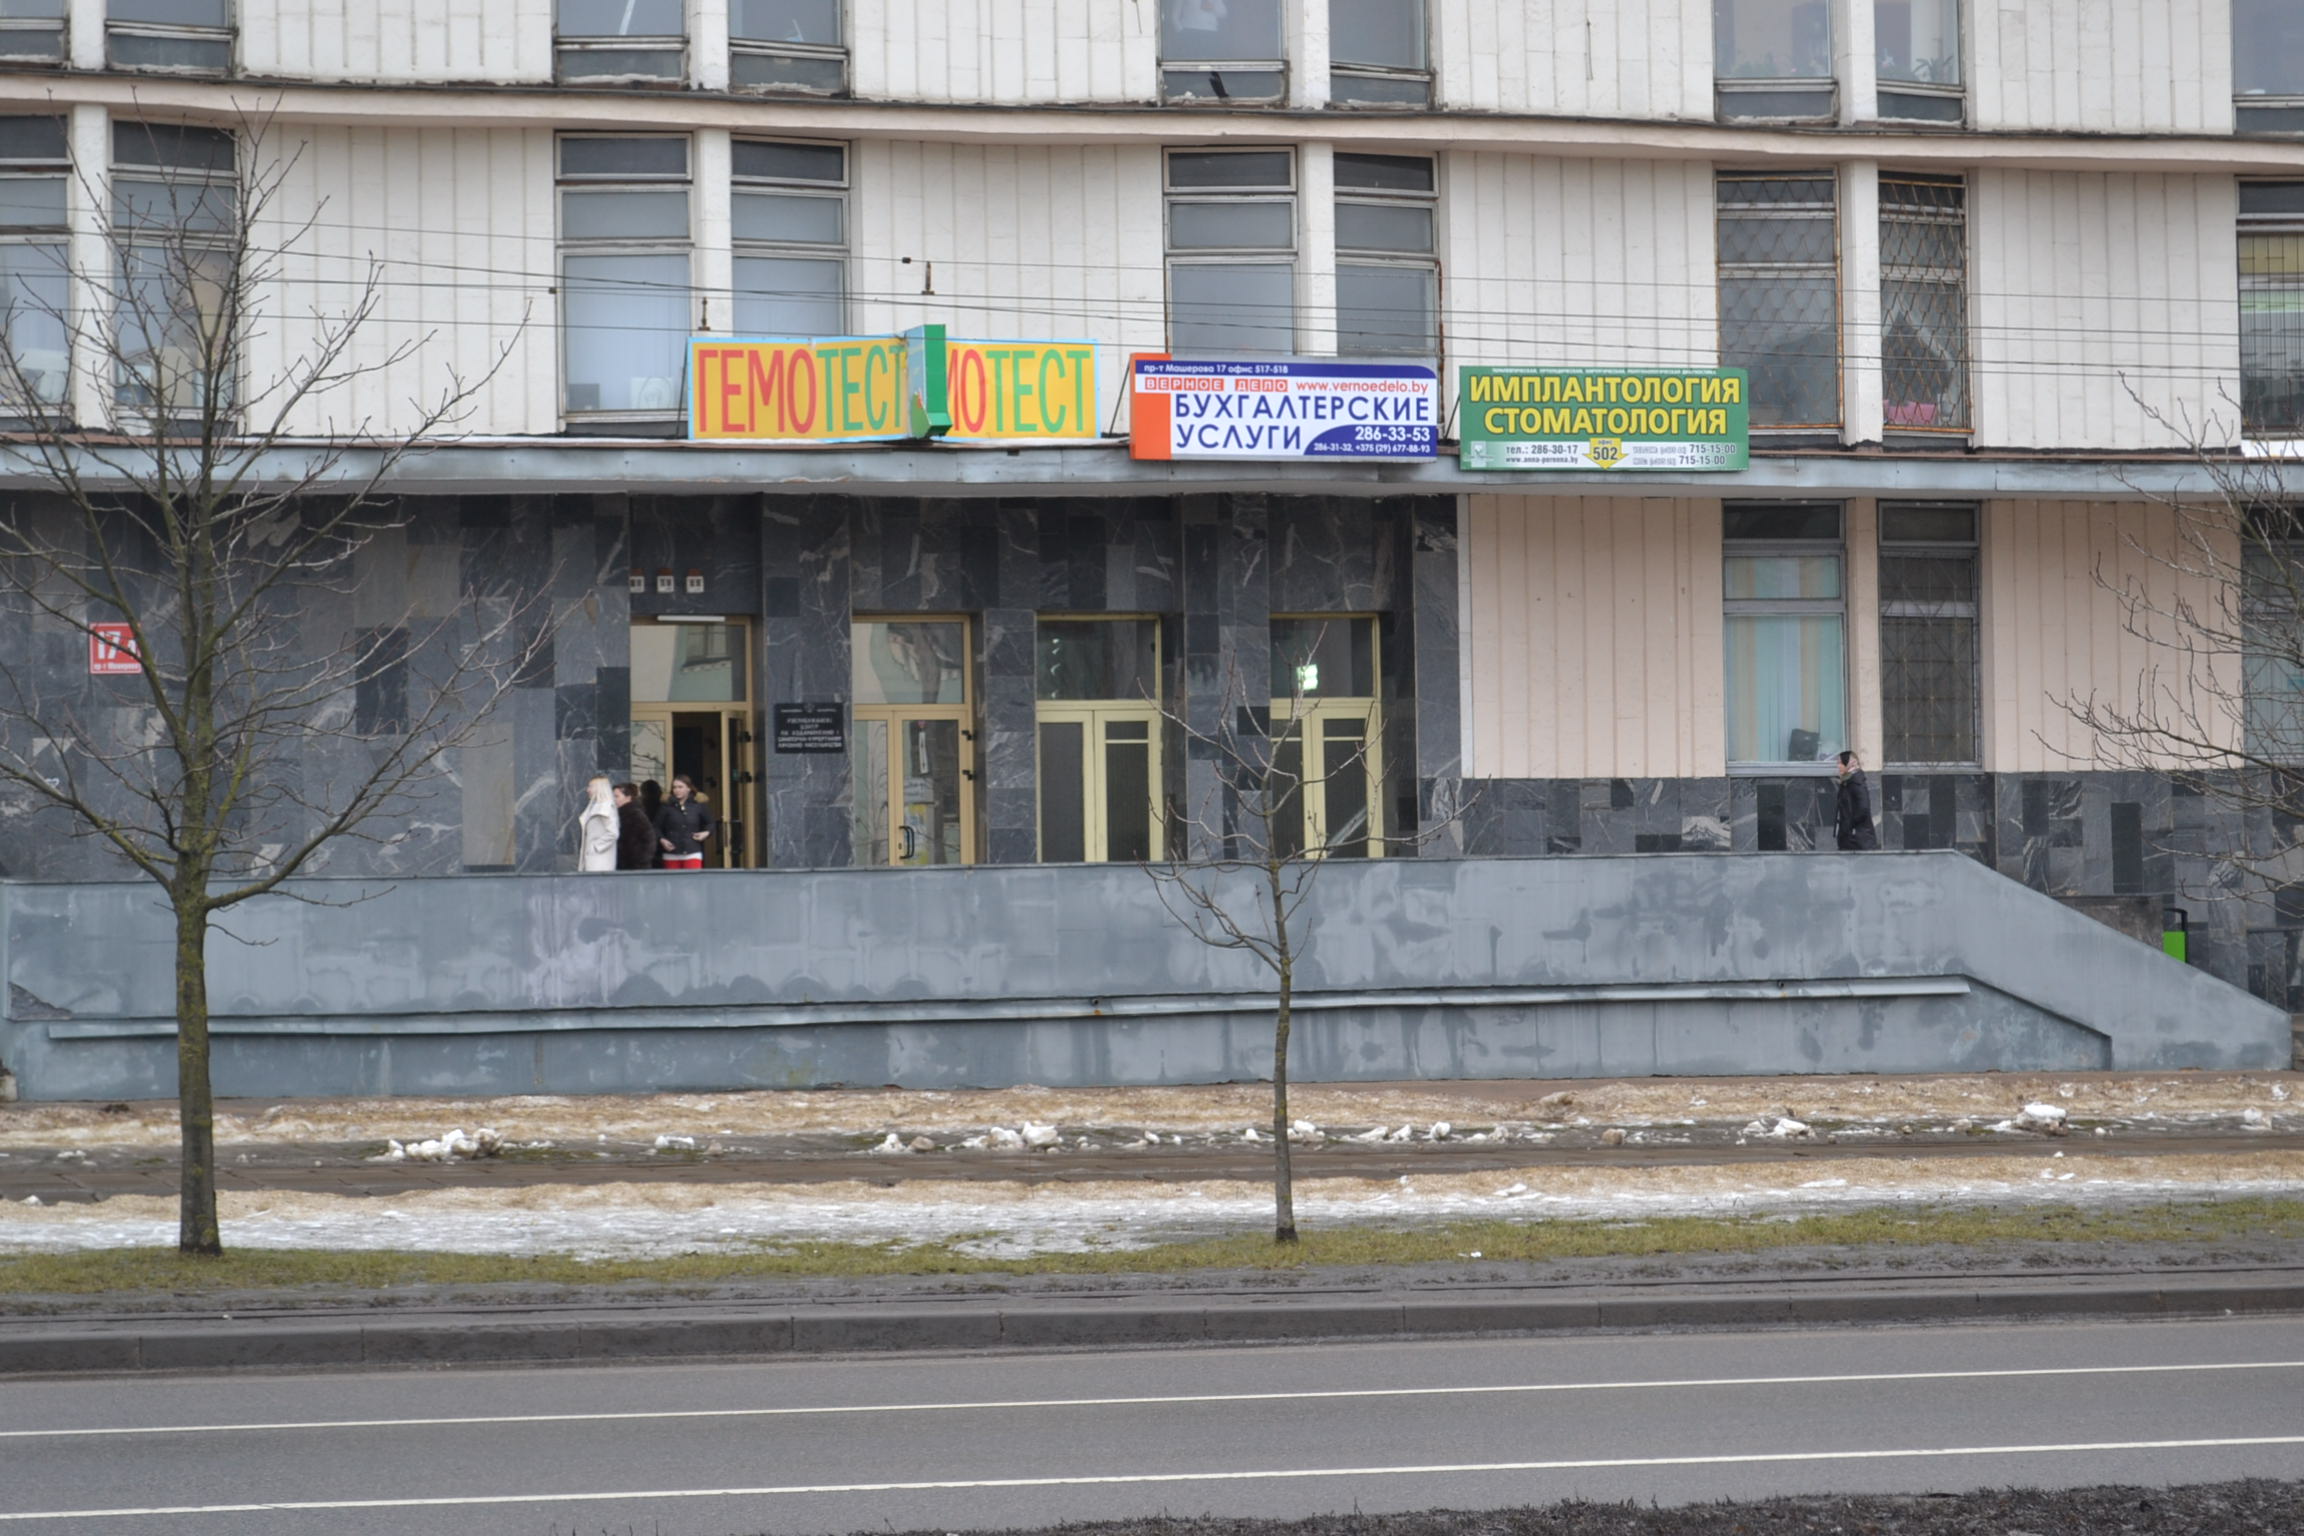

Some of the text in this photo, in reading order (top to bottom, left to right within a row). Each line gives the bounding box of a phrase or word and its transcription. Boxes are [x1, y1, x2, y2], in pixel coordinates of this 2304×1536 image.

[1144, 364, 1288, 375] пр-т Машерова 17 офис 517-518
[698, 344, 906, 434] ГЕМОТЕСТ
[1146, 378, 1287, 391] ВЕРНОЕ ДЕЛО
[1296, 380, 1429, 395] www.vernoedelo.by
[1470, 375, 1740, 404] ИМПЛАНТОЛОГИЯ
[1175, 394, 1429, 421] БУХГАЛТЕРСКИЕ
[1484, 407, 1727, 435] СТОМАТОЛОГИЯ
[1176, 424, 1300, 450] УСЛУГИ
[1355, 426, 1430, 441] 286-33-53
[1375, 444, 1391, 454] (29)
[1593, 447, 1618, 460] 502
[1689, 444, 1735, 453] 715-15-00
[1679, 455, 1725, 465] 715-15-00
[98, 631, 121, 659] 17
